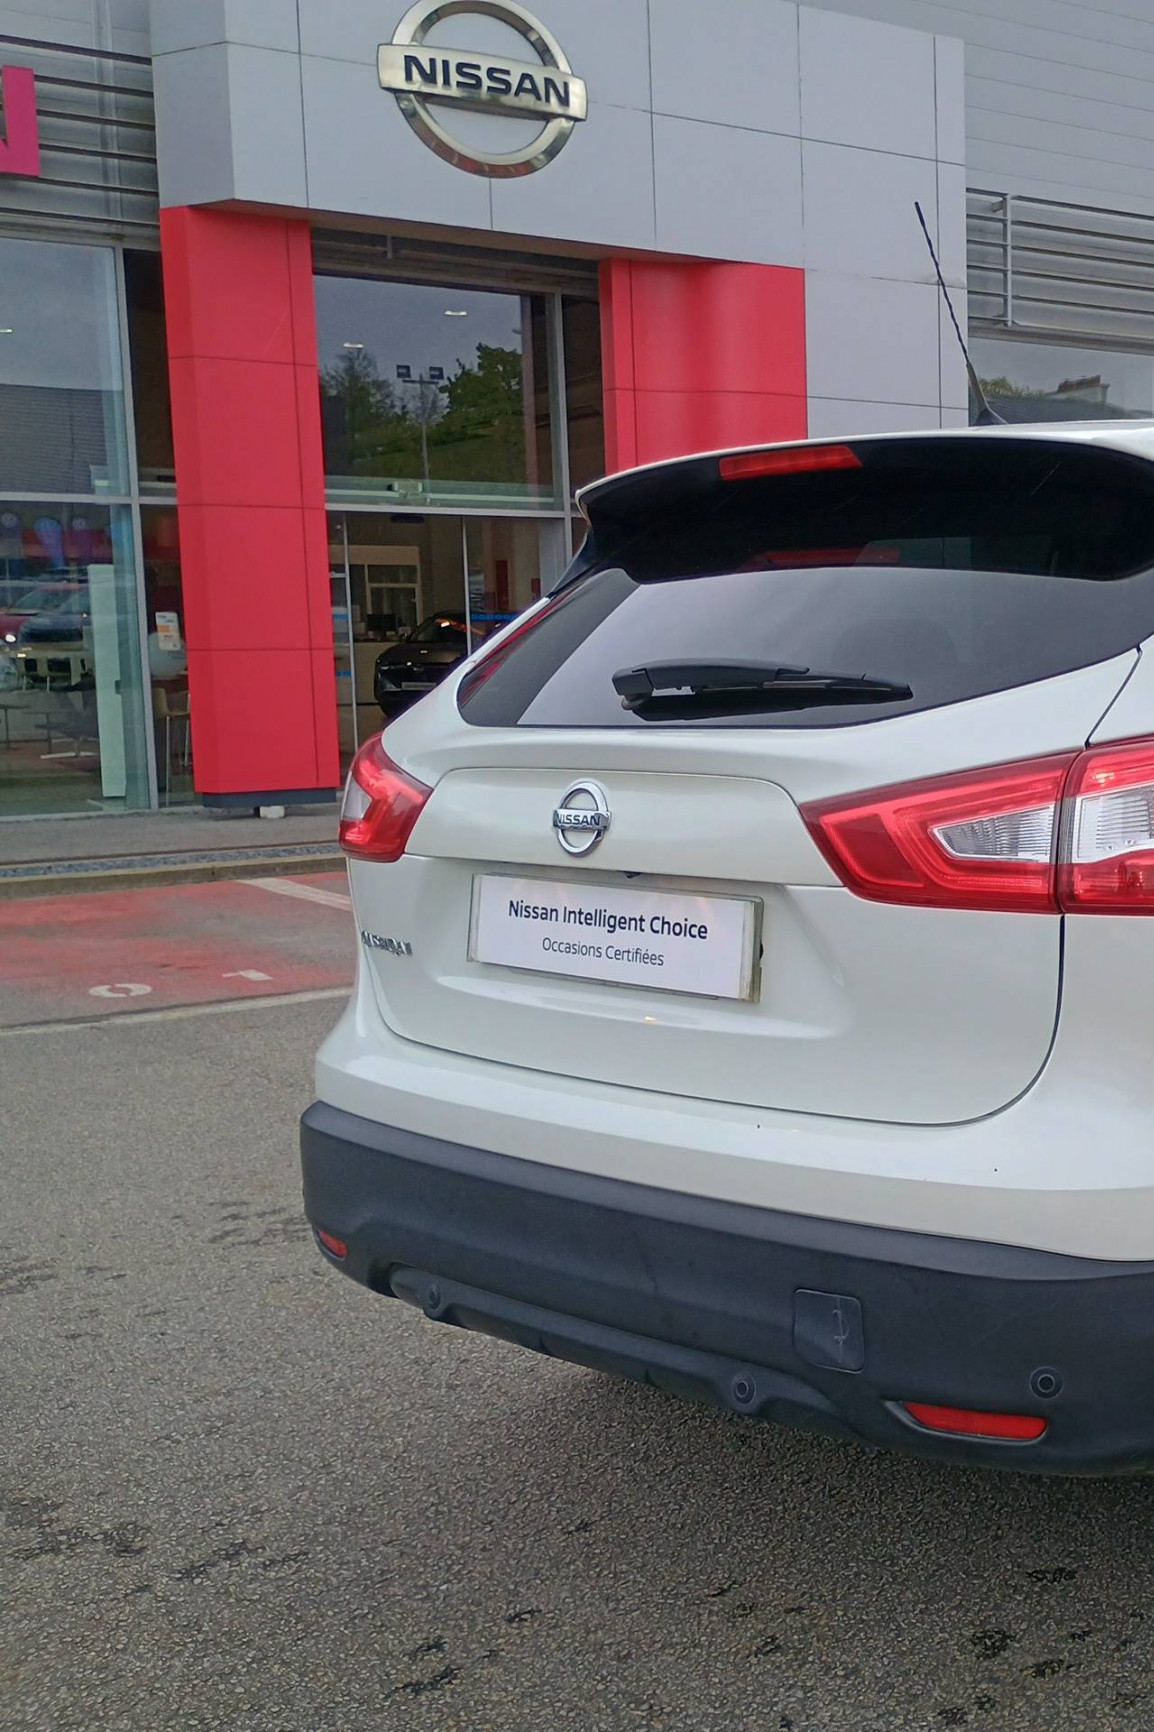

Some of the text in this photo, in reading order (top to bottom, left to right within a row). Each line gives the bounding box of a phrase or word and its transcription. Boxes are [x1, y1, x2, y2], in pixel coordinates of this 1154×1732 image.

[403, 54, 571, 108] NISSAN
[557, 812, 601, 827] NISSAN
[508, 900, 708, 940] Nissan Intelligent Choice
[542, 937, 664, 967] Occasions Certifiées
